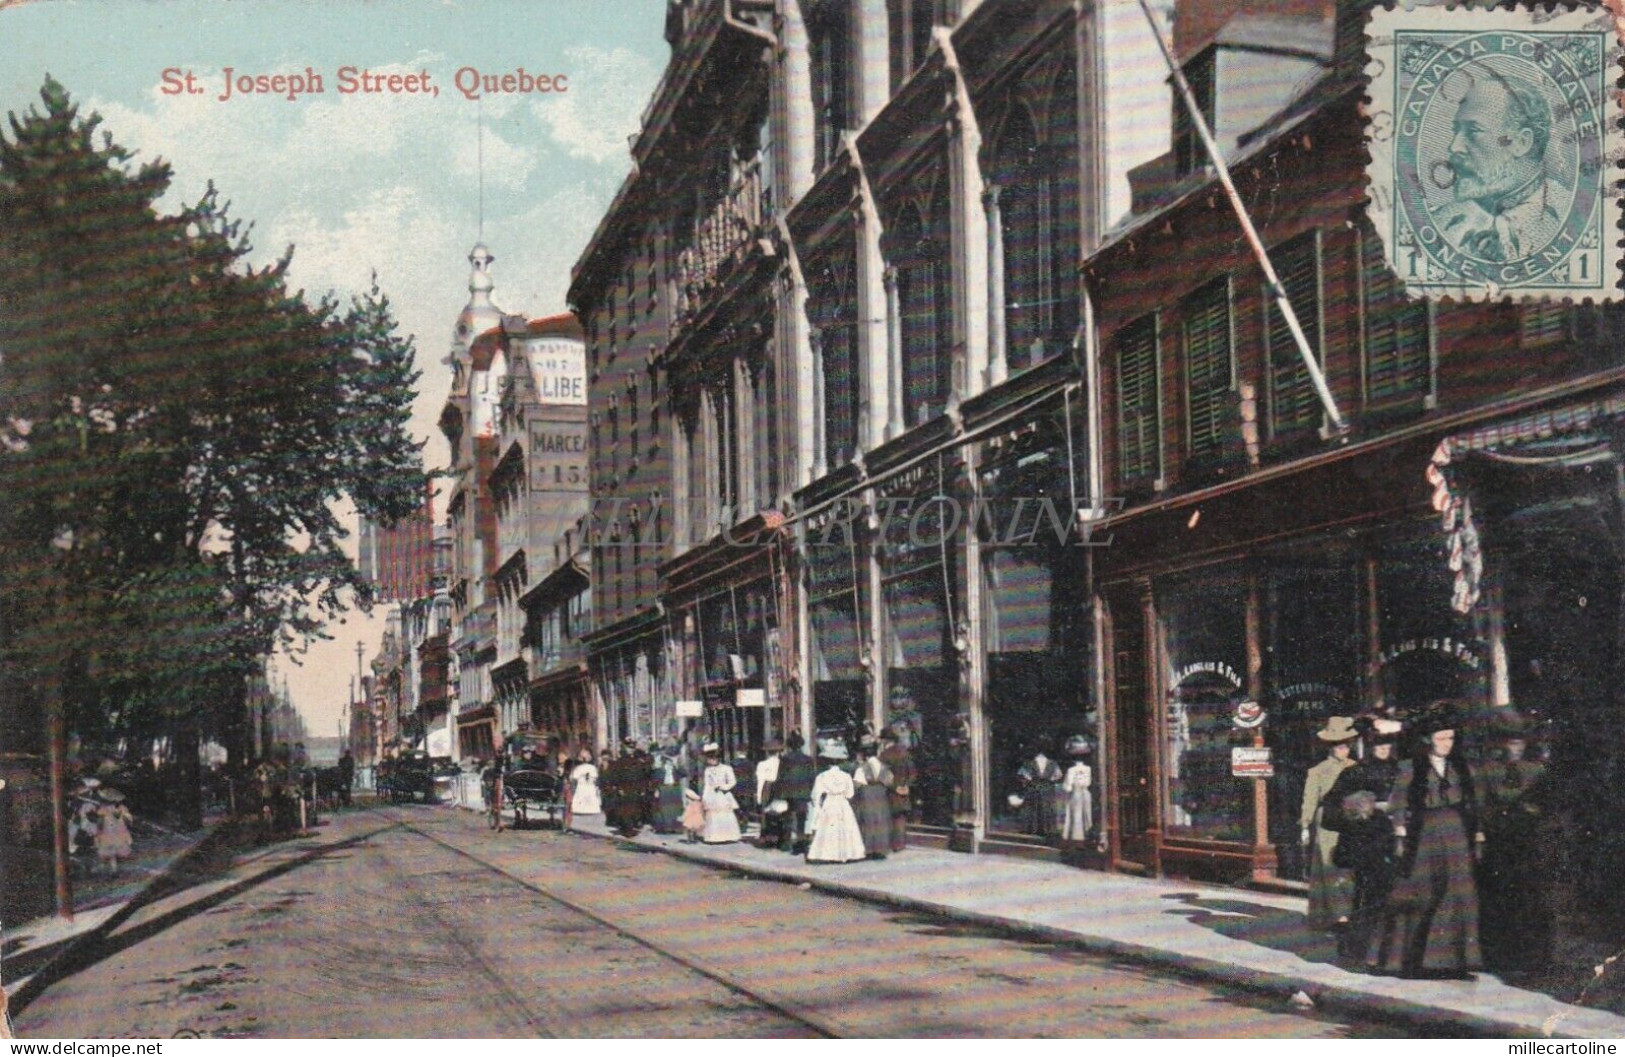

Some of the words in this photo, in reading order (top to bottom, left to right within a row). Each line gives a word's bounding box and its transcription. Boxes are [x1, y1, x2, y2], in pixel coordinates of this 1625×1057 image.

[1402, 38, 1487, 137] CANADA
[1500, 36, 1595, 138] POSTAGE
[1406, 250, 1417, 278] 1
[1419, 224, 1474, 278] ONE
[1500, 227, 1576, 282] CENT
[1578, 252, 1590, 279] 1
